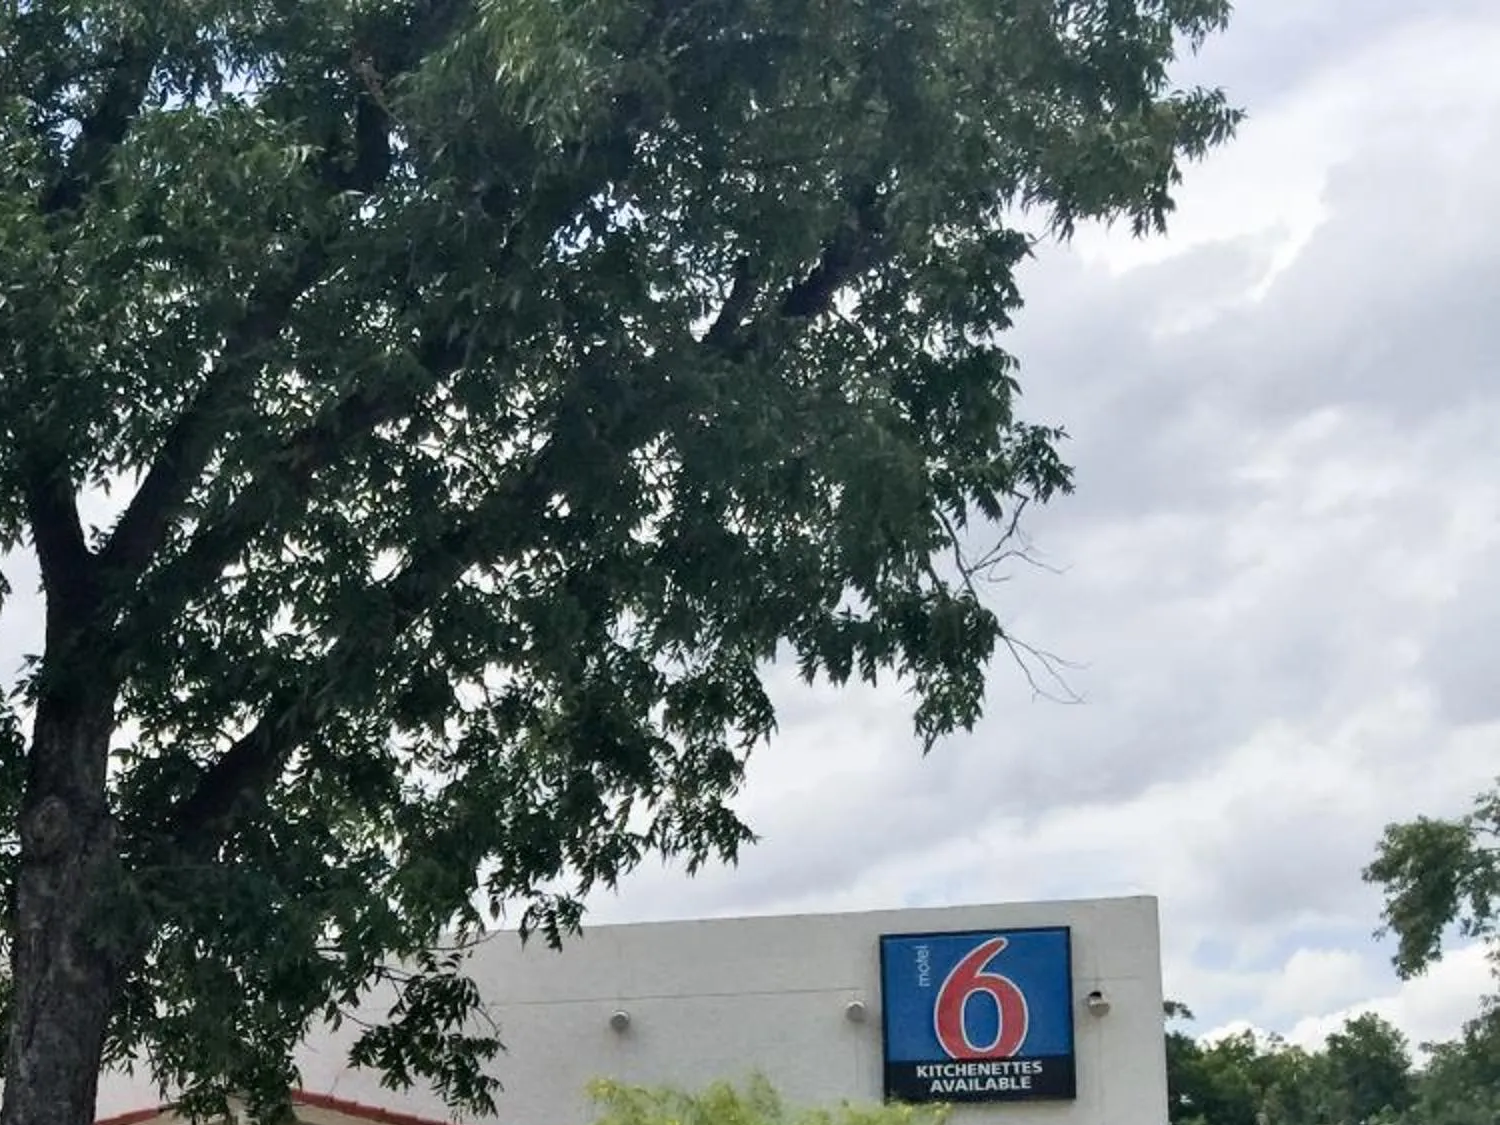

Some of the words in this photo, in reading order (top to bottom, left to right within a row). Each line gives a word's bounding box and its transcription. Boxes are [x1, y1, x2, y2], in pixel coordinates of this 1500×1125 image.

[915, 944, 931, 988] motel
[934, 937, 1029, 1059] 6
[916, 1061, 1043, 1077] KITCHENETTES
[930, 1076, 1032, 1093] AVAILABLE
